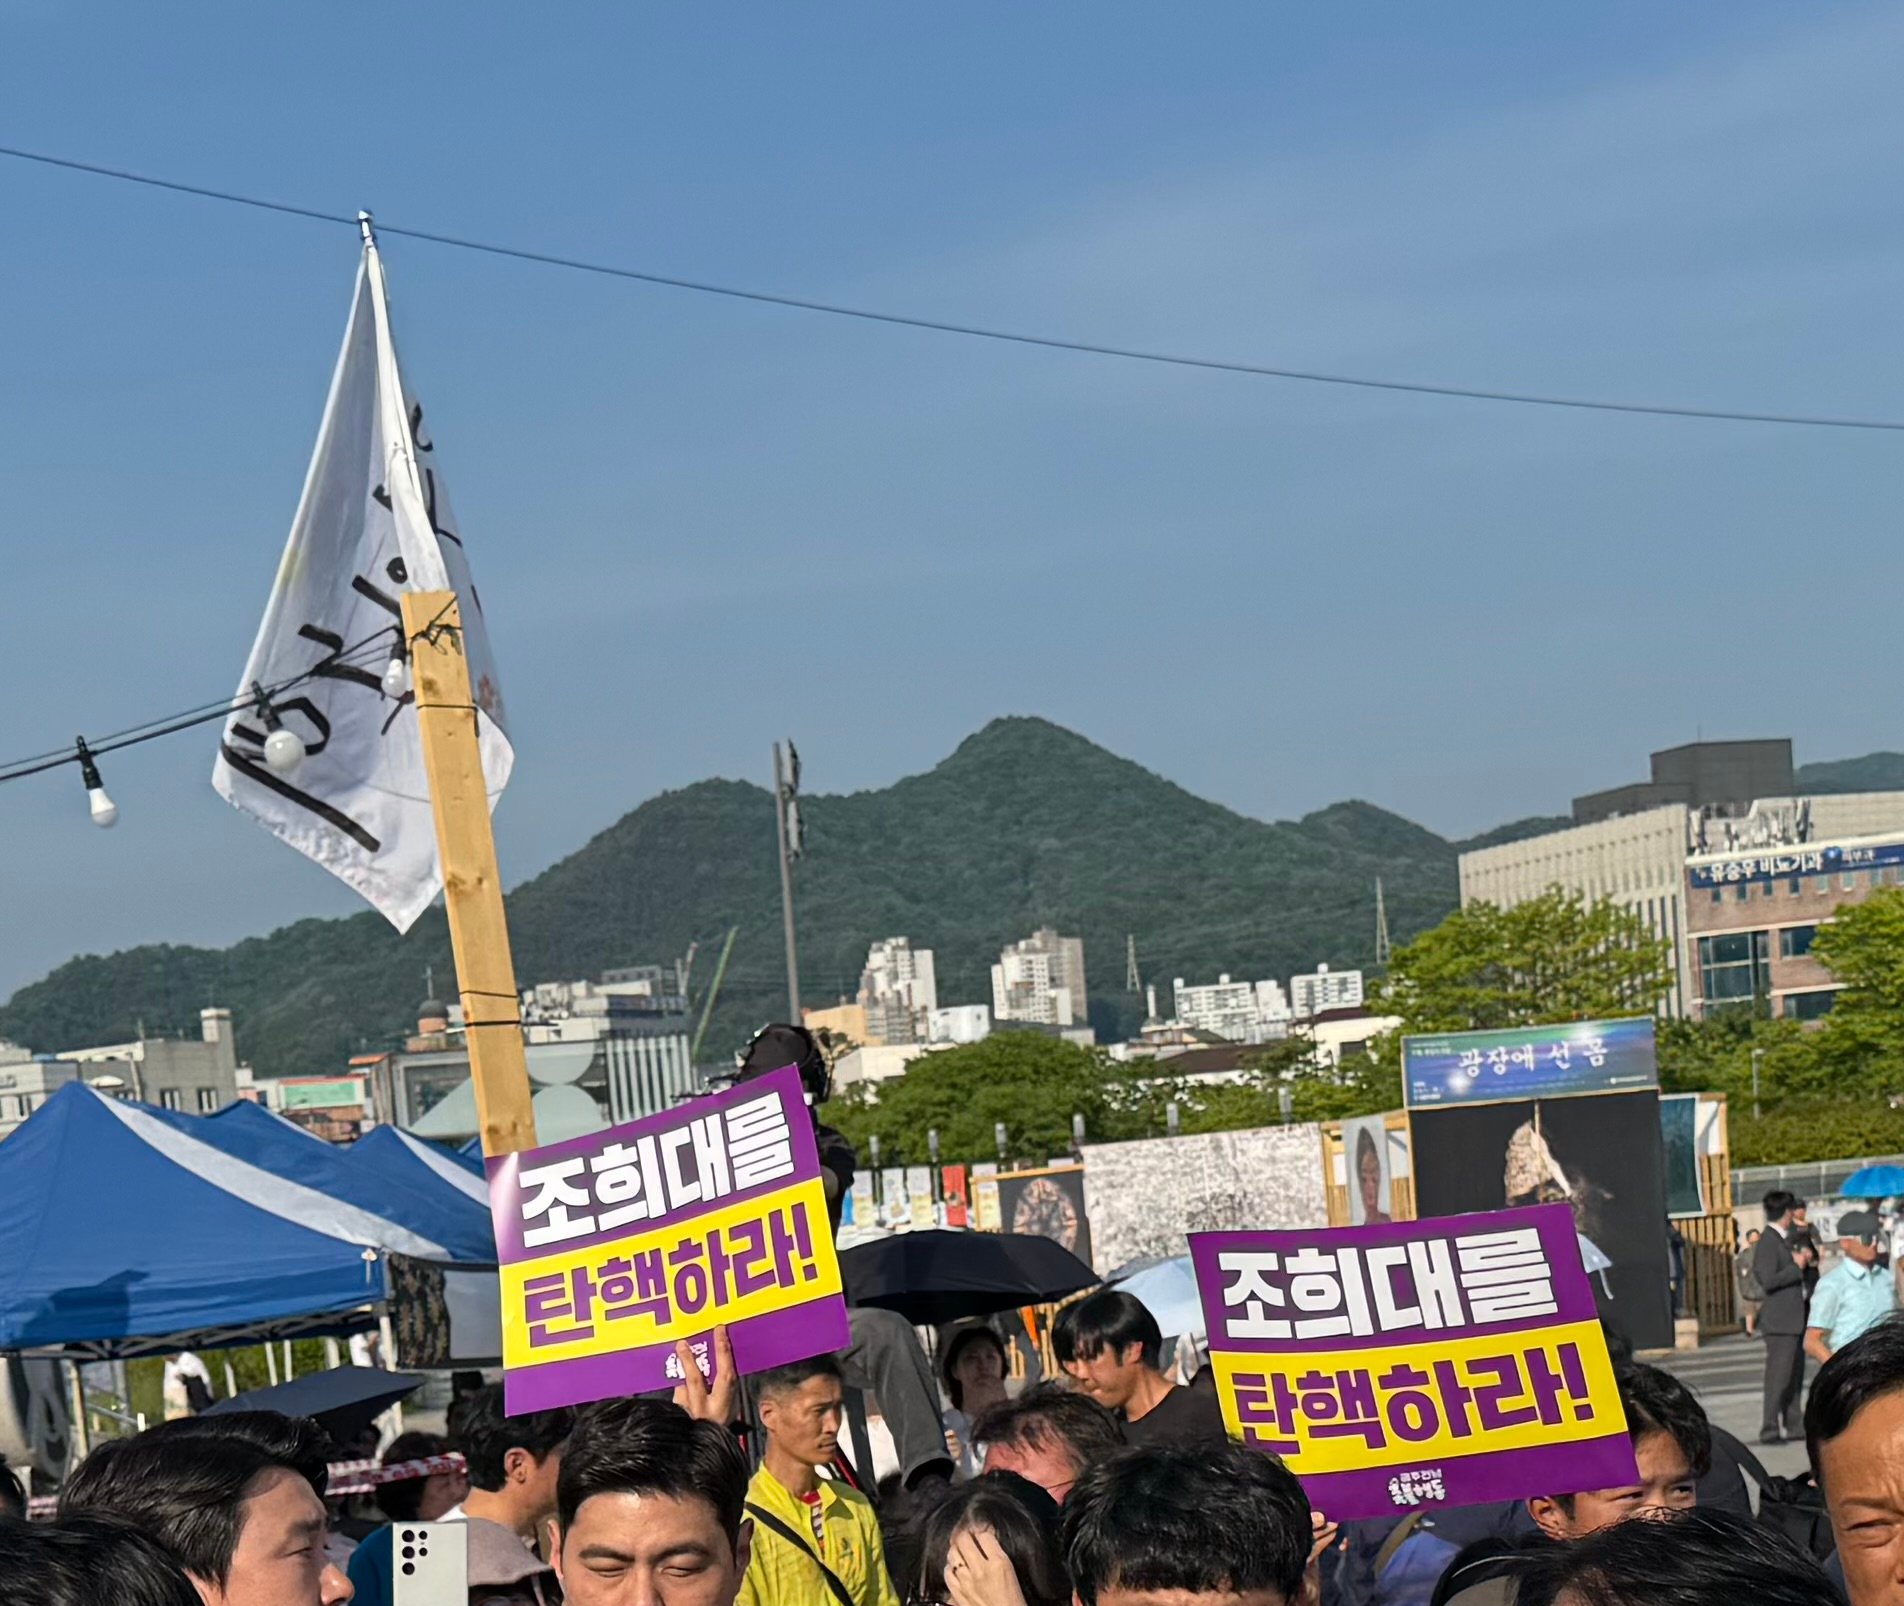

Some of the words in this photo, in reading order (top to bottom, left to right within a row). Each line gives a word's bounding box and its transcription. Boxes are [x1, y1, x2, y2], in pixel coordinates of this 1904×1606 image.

[1458, 1043, 1535, 1078] 광장에
[1548, 1040, 1572, 1070] 선
[517, 1091, 796, 1249] 조희대를
[523, 1201, 819, 1349] 탄핵하라!
[1217, 1227, 1559, 1340] 조희대를
[1231, 1341, 1595, 1455] 탄핵하라!
